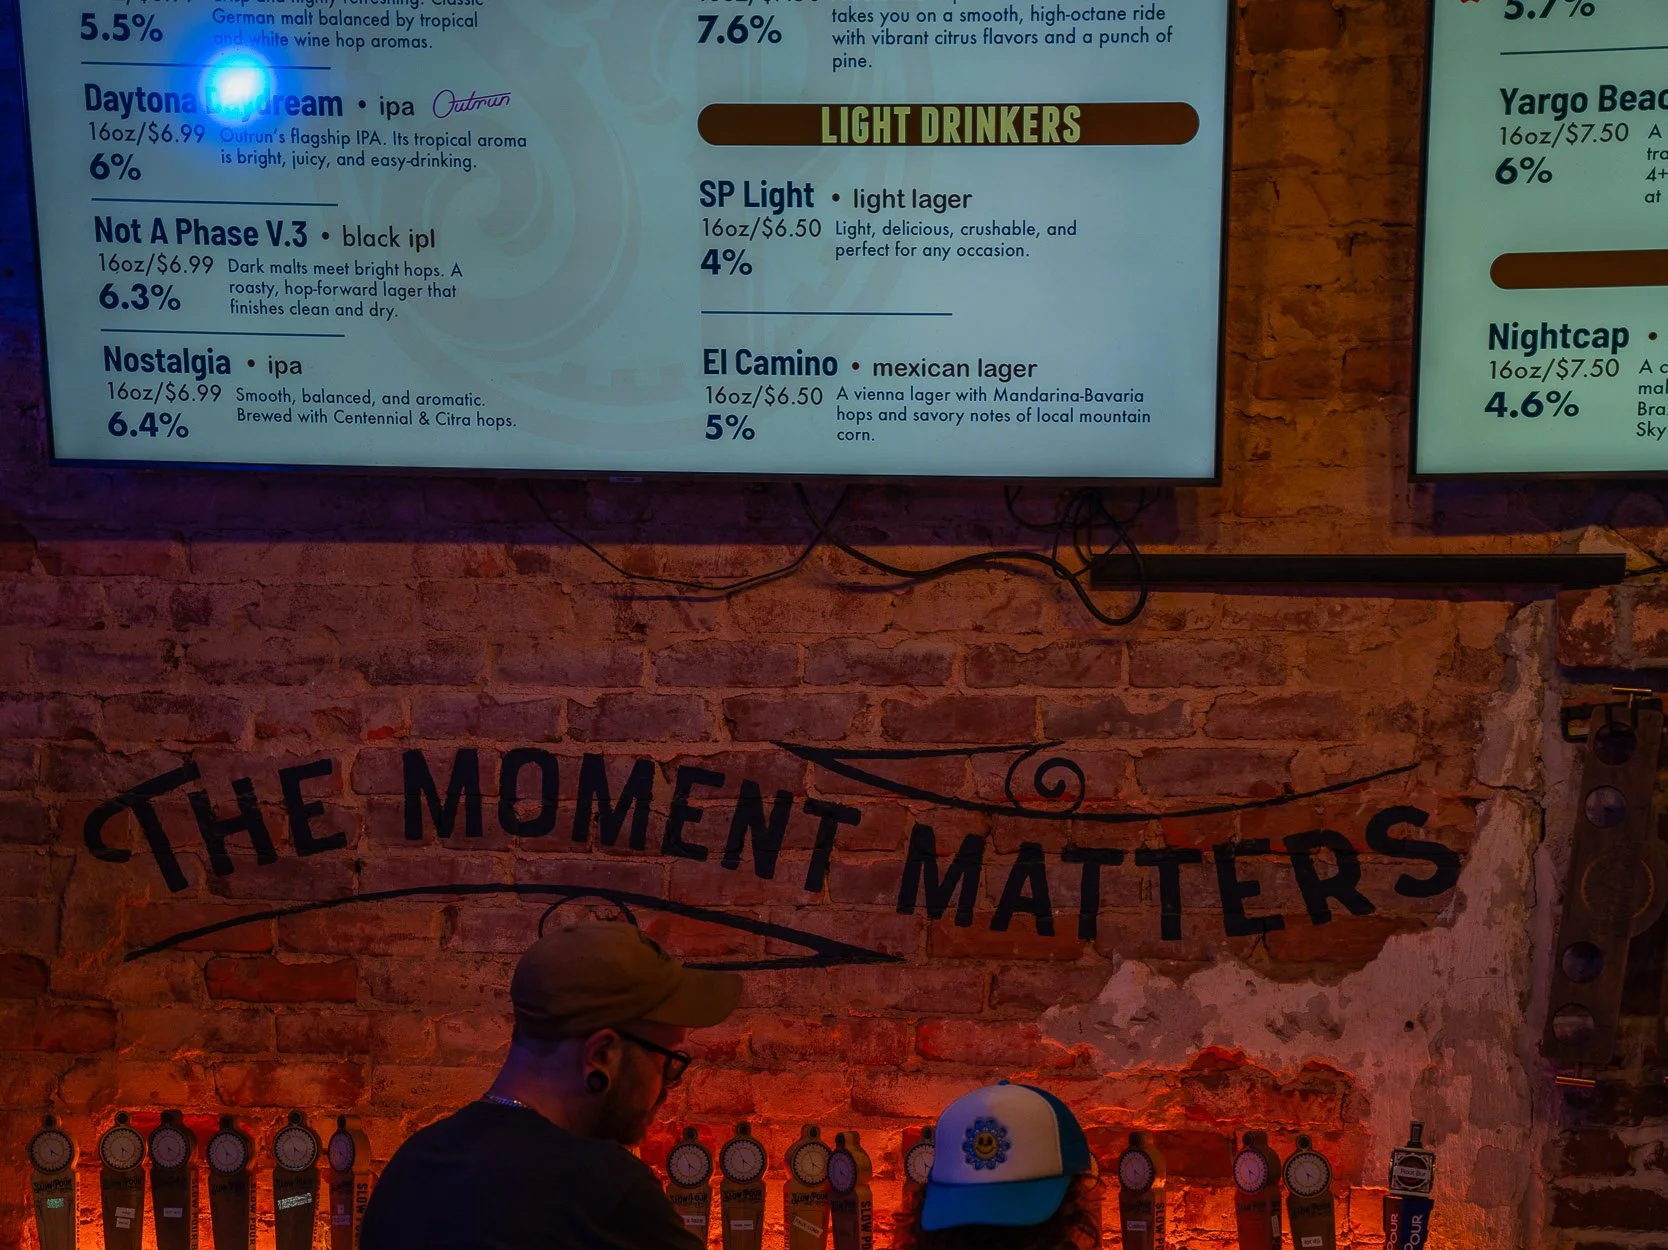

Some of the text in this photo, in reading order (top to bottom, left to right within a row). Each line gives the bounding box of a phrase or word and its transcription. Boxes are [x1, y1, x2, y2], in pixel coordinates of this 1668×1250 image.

[212, 8, 477, 32] German malt balanced by tropical
[832, 3, 1165, 27] takes you on a smooth, high-octane ride
[1504, 0, 1595, 20] 5.7%
[81, 13, 163, 42] 5.5%
[698, 15, 782, 44] 7.6%
[832, 25, 1173, 48] with vibrant citrus flavors and a punch of
[213, 29, 432, 52] and white wine hop aromas.
[833, 53, 871, 72] pine.
[85, 83, 192, 119] Daytona
[380, 96, 414, 120] ipa
[1500, 88, 1588, 121] Yargo
[89, 121, 204, 146] 16oz/$6.99
[822, 105, 1080, 143] LIGHT DRINKERS
[1501, 122, 1628, 148] 16oz/$7.50
[1648, 124, 1662, 139] A
[291, 128, 350, 149] flagship
[357, 130, 386, 145] IPA.
[393, 131, 409, 145] Its
[414, 131, 471, 150] tropical
[478, 137, 526, 147] aroma
[90, 153, 141, 180] 6%
[221, 148, 476, 172] is bright, juicy, and easy-drinking.
[1495, 157, 1552, 184] 6%
[700, 180, 972, 215] SP Light light lager
[1645, 190, 1661, 203] at
[95, 216, 434, 252] Not A Phase V.3 black ipl
[703, 216, 821, 241] 16oz/$6.50
[836, 220, 1076, 239] Light, delicious, crushable, and
[701, 249, 752, 275] 4%
[836, 241, 1029, 261] perfect for any occasion.
[99, 252, 213, 276] 16oz/$6.99
[228, 258, 462, 280] Dark malts meet bright hops. A
[99, 283, 180, 310] 6.3%
[230, 279, 456, 301] roasty, hop-forward lager that
[231, 298, 397, 321] finishes clean and dry.
[1489, 322, 1629, 357] Nightcap
[104, 346, 302, 381] Nostalgia ipa
[704, 349, 1037, 382] El Camino mexican lager
[1490, 357, 1619, 382] 16oz/$7.50
[1639, 359, 1653, 374] A
[108, 381, 221, 404] 16oz/$6.99
[236, 387, 485, 407] Smooth, balanced, and aromatic.
[706, 385, 822, 408] 16oz/$6.50
[836, 386, 1143, 405] A vienna lager with Mandarina-Bavaria
[1485, 391, 1579, 418] 4.6%
[238, 408, 516, 431] Brewed with Centennial & Citra hops.
[837, 405, 1150, 426] hops and savory notes of local mountain
[1638, 402, 1668, 416] Bra
[108, 411, 188, 438] 6.4%
[706, 415, 755, 440] 5%
[837, 432, 874, 441] corn.
[83, 759, 346, 893] THE
[402, 748, 861, 893] MOMENT
[896, 805, 1462, 942] MATTERS
[860, 1201, 872, 1233] SLOW
